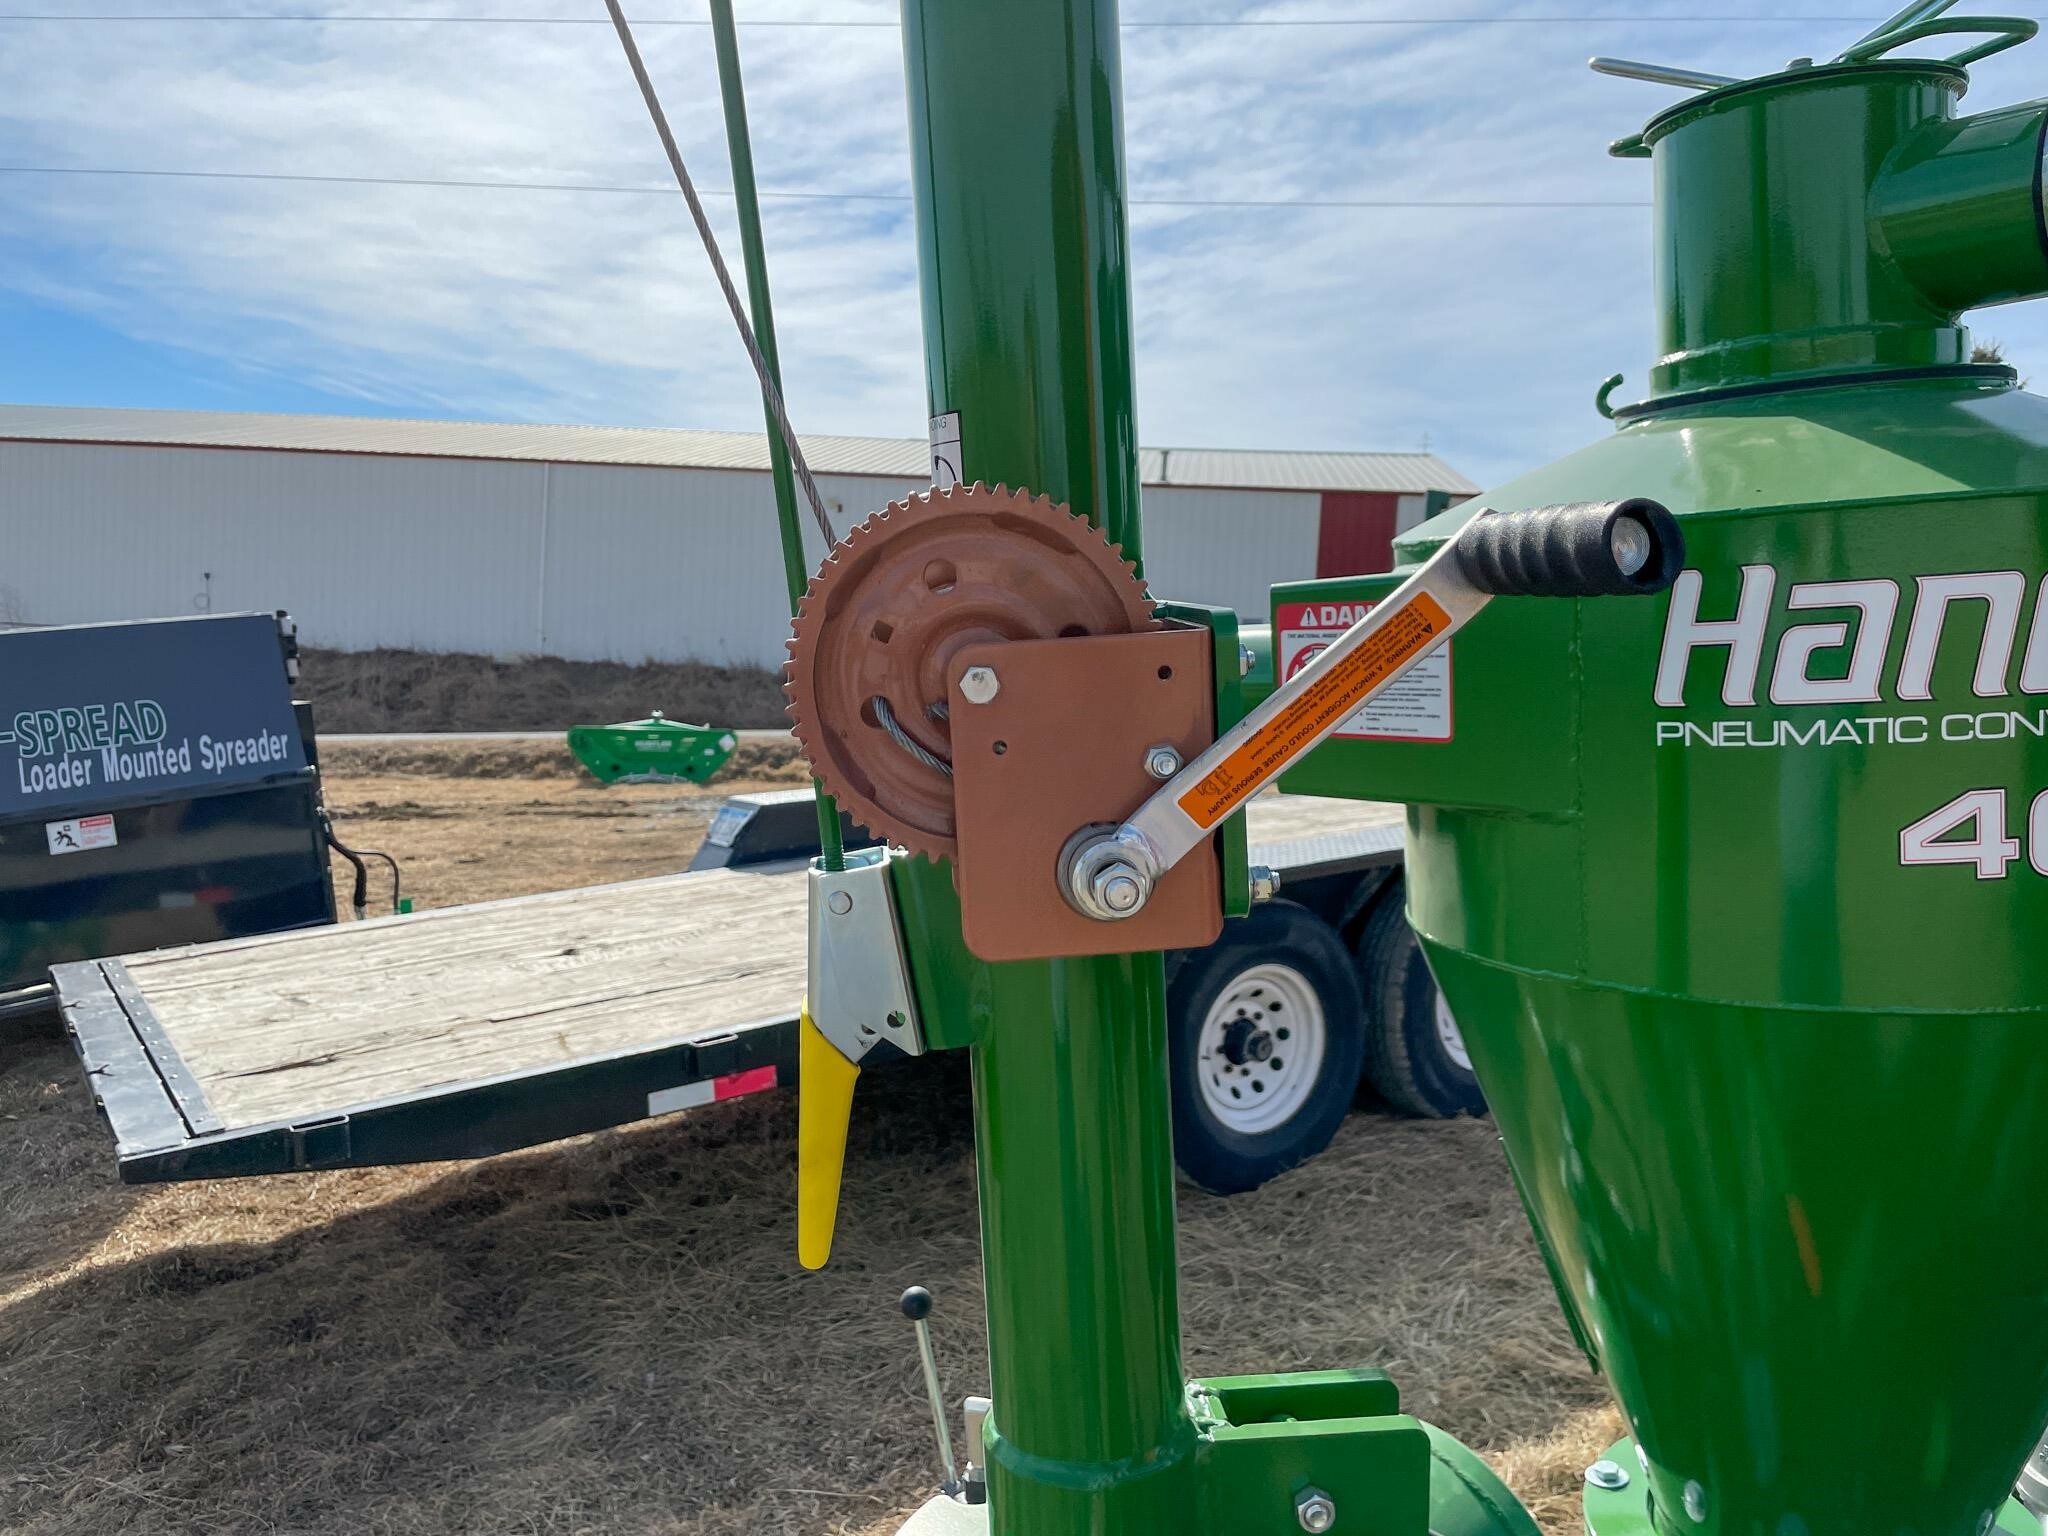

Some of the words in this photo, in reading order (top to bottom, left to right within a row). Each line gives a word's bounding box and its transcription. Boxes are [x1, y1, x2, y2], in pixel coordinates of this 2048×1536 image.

[1321, 605, 1374, 626] DAN
[1654, 564, 2048, 707] Han
[1349, 669, 1377, 694] WINCH
[1313, 691, 1352, 725] ACCIDENT
[1287, 722, 1315, 747] COULD
[1656, 716, 1928, 746] PNEUMATIC
[1941, 709, 2048, 740] CON
[18, 751, 92, 793] Loader
[101, 739, 191, 783] Mounted
[199, 729, 288, 774] Spreader
[1261, 743, 1289, 769] CAUSE
[1230, 765, 1264, 795] SERIOUS
[1205, 791, 1233, 816] INJURY
[1900, 787, 2048, 879] 4
